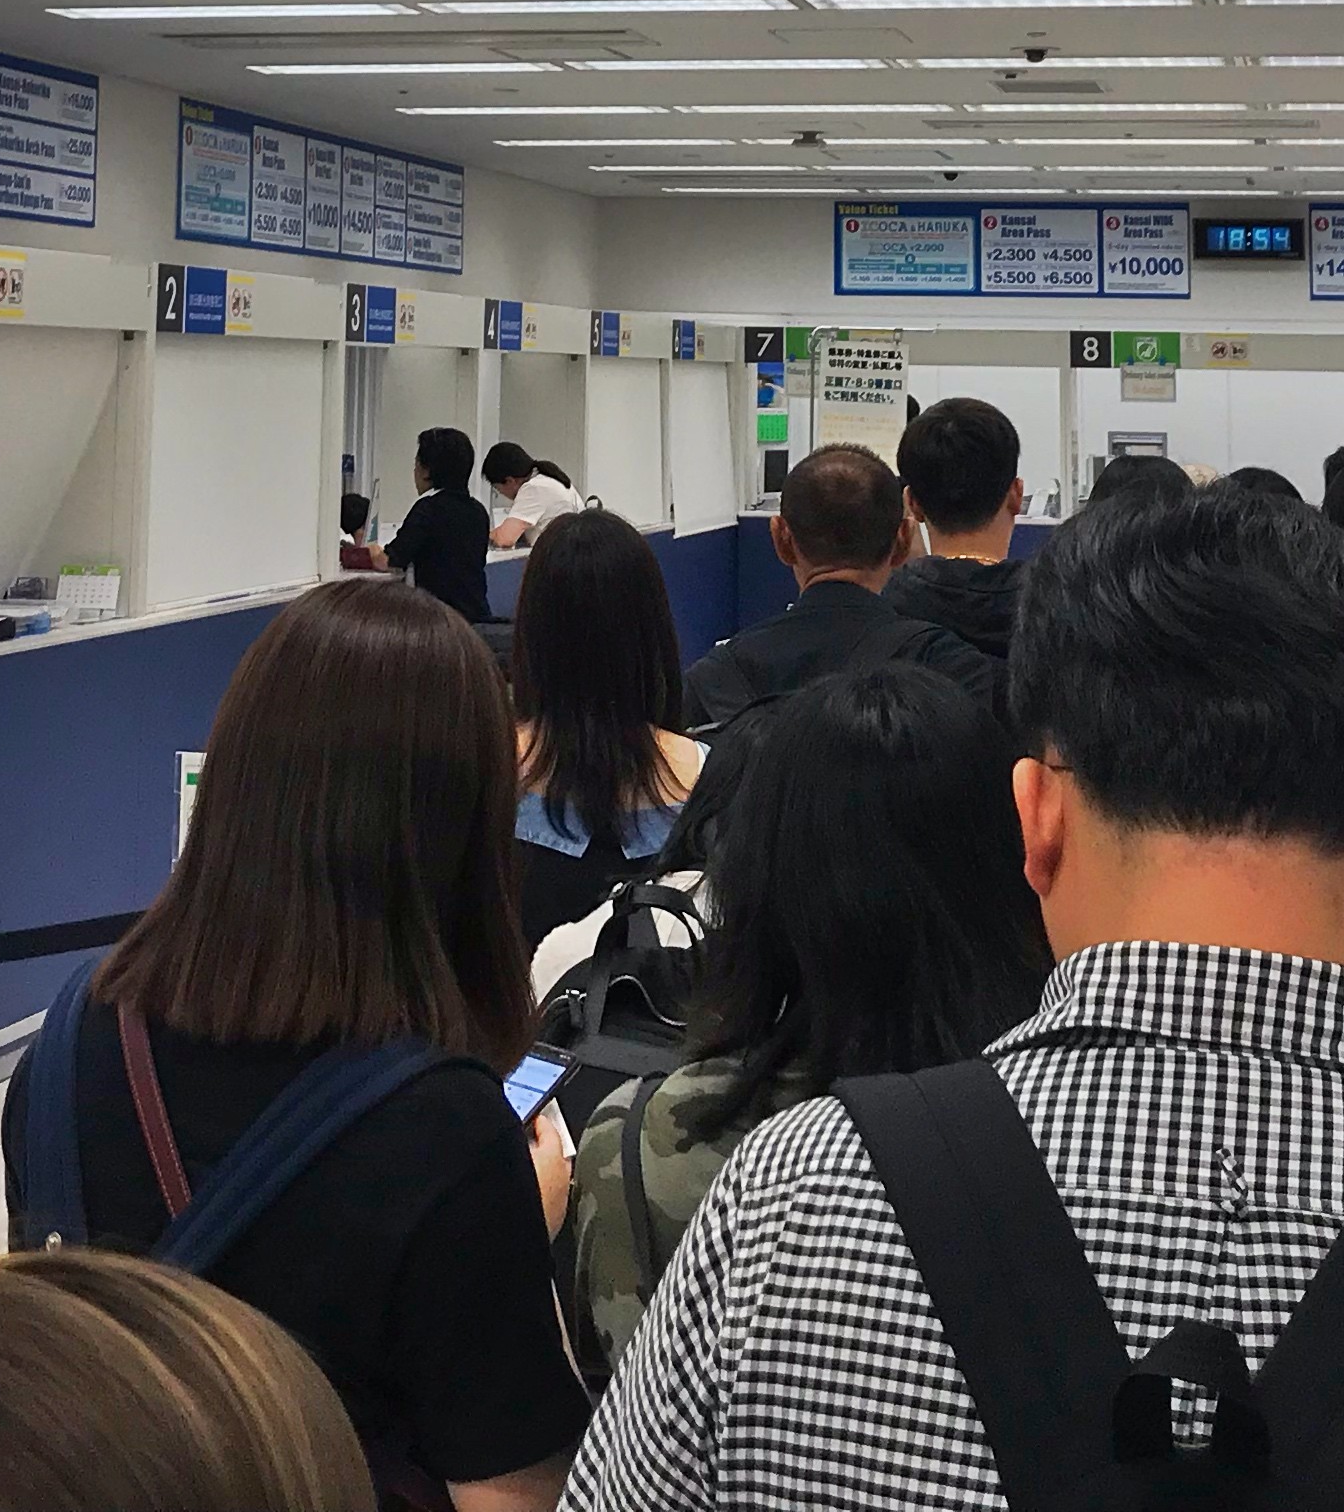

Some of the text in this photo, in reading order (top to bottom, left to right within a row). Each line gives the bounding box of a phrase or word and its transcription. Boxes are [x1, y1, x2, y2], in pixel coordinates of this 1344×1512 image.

[838, 204, 899, 215] Value Ticket
[918, 221, 968, 233] HARUKA
[1001, 215, 1036, 226] Kansai
[1123, 215, 1174, 227] Kansai WIDE
[1001, 227, 1051, 238] Area Pass
[1123, 227, 1163, 238] Area Pass
[1219, 229, 1291, 250] 18:54
[986, 249, 1093, 262] ¥2,300 ¥4,500
[1109, 257, 1184, 277] ¥10,000
[986, 272, 1093, 285] ¥5,500 ¥6,500
[165, 276, 177, 320] 2
[351, 293, 360, 332] 3
[486, 309, 495, 340] 4
[592, 318, 599, 346] 5
[757, 333, 774, 357] 7
[1083, 337, 1099, 362] 8
